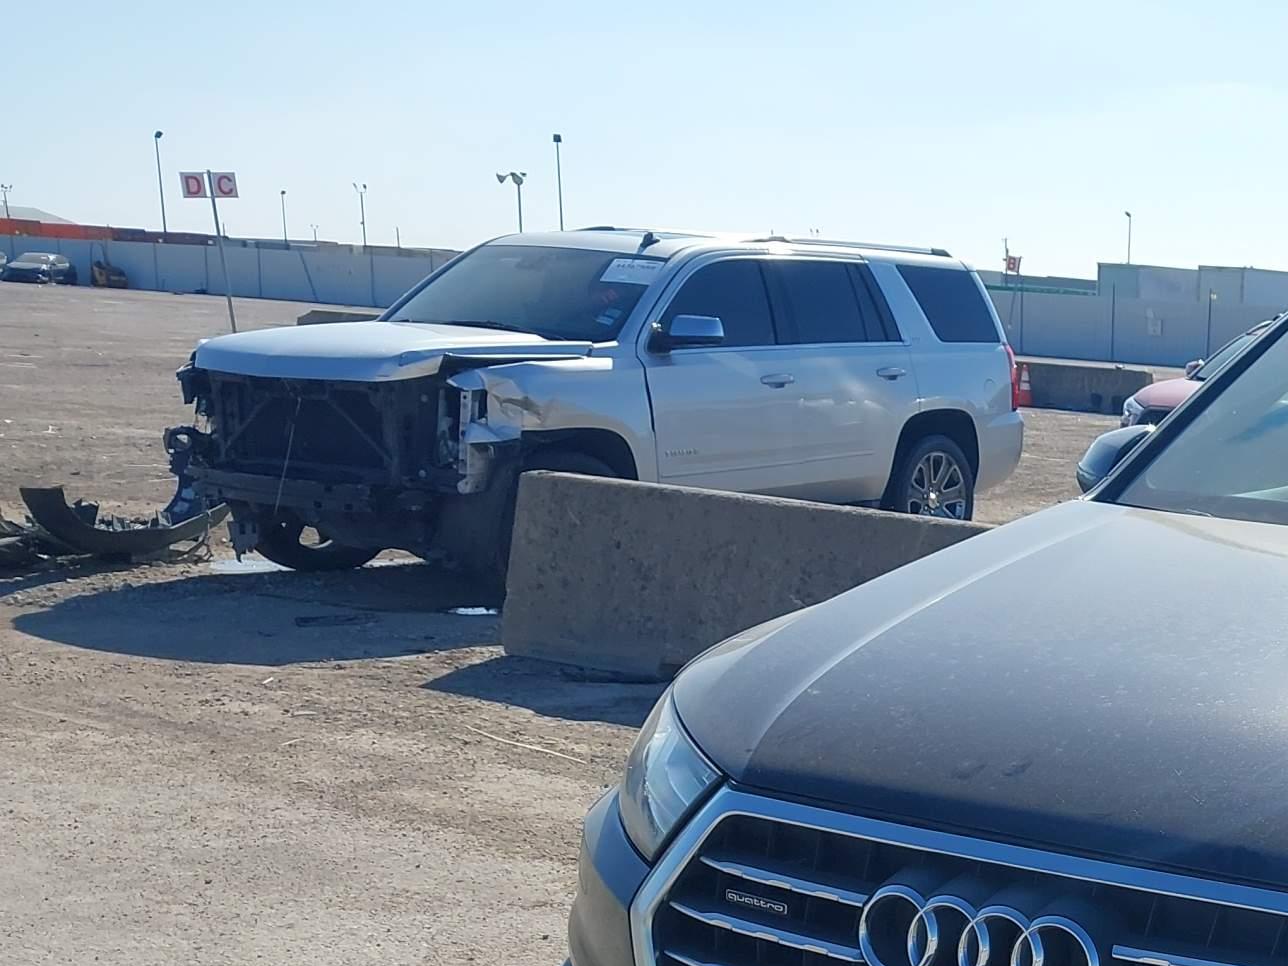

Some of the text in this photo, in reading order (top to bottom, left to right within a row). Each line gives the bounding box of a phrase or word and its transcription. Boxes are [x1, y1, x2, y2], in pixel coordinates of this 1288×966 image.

[183, 175, 202, 195] D
[217, 175, 233, 195] C
[728, 892, 784, 912] quattro
